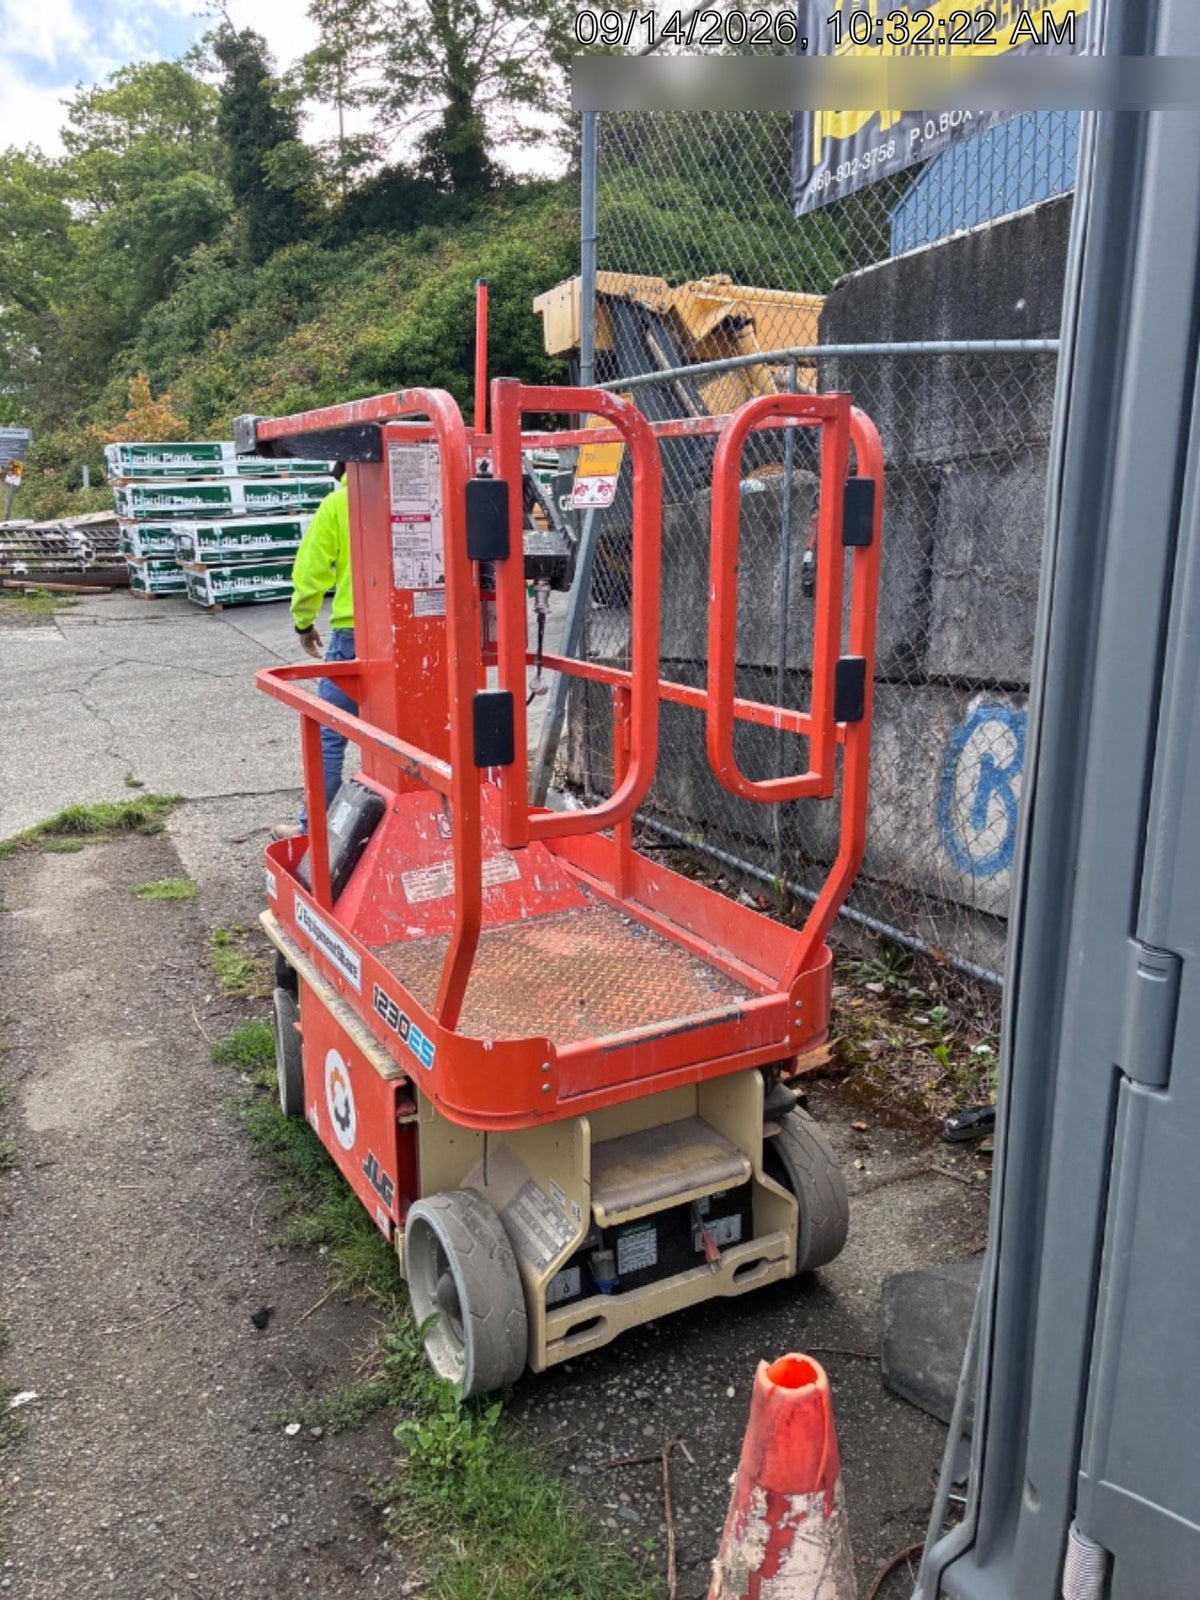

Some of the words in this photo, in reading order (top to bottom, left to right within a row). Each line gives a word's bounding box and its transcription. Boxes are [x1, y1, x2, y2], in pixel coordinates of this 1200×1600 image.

[282, 490, 309, 501] Plak
[200, 536, 238, 547] Hadie
[241, 533, 272, 544] Plank
[374, 984, 434, 1069] 1230ES
[362, 1151, 395, 1210] JLG
